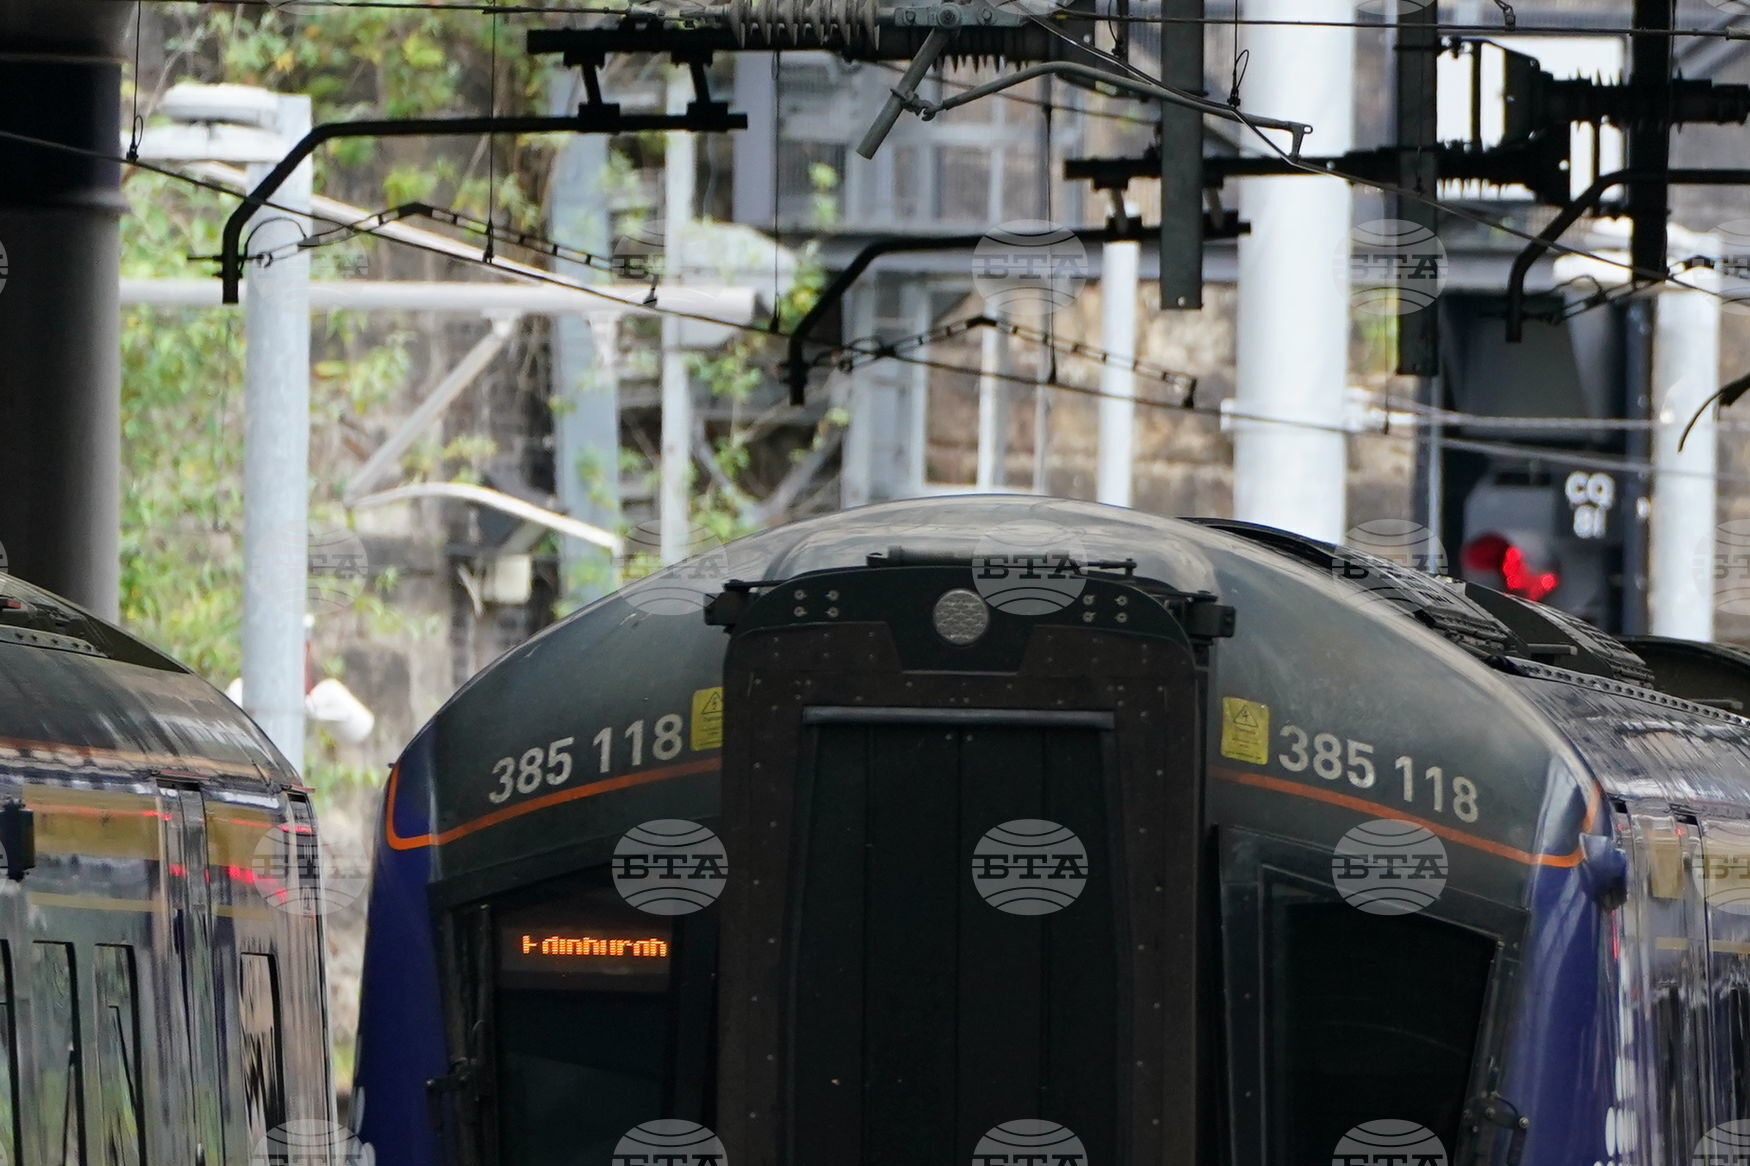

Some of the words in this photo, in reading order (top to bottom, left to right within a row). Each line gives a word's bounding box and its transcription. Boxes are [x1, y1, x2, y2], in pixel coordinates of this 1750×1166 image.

[488, 736, 576, 805] 385
[592, 713, 683, 774] 118
[1278, 724, 1377, 790] 385
[1395, 755, 1481, 824] 118
